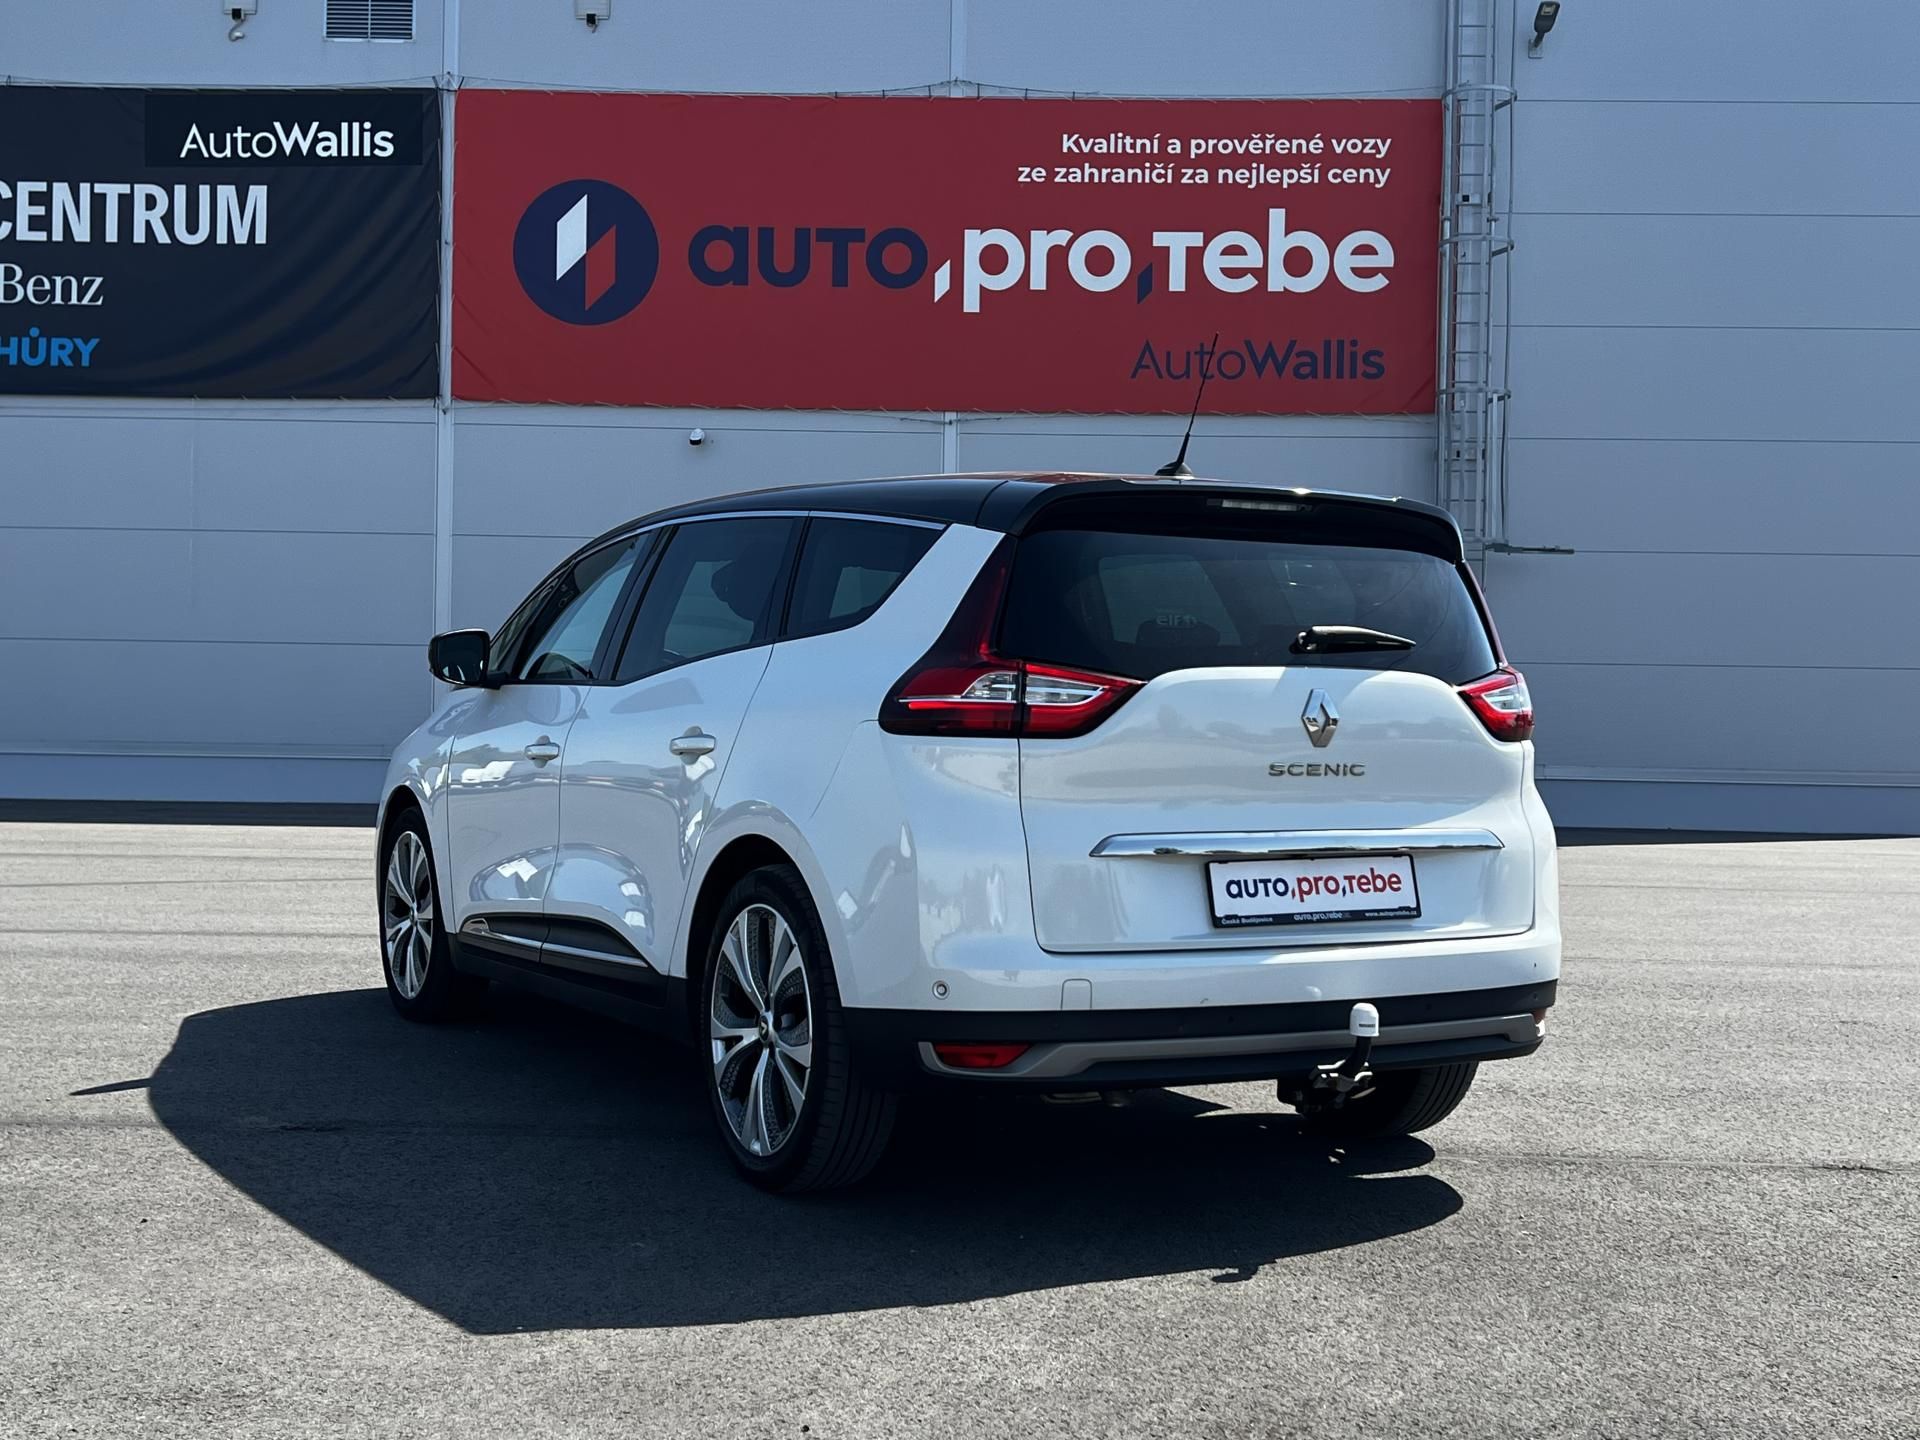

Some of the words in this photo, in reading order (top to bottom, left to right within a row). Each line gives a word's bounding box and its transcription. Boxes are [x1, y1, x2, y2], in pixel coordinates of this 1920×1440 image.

[180, 121, 395, 159] AutoWallis
[1062, 133, 1160, 154] Kvalitní
[1167, 138, 1181, 154] a
[1190, 134, 1324, 158] prověřené
[1332, 138, 1392, 158] vozy
[1018, 167, 1046, 183] ze
[1054, 164, 1173, 184] zahraničí
[1181, 169, 1208, 184] za
[1218, 164, 1320, 188] nejlepší
[1328, 169, 1391, 187] ceny
[1130, 339, 1386, 381] AutoWallis
[1268, 762, 1366, 777] SCENIC
